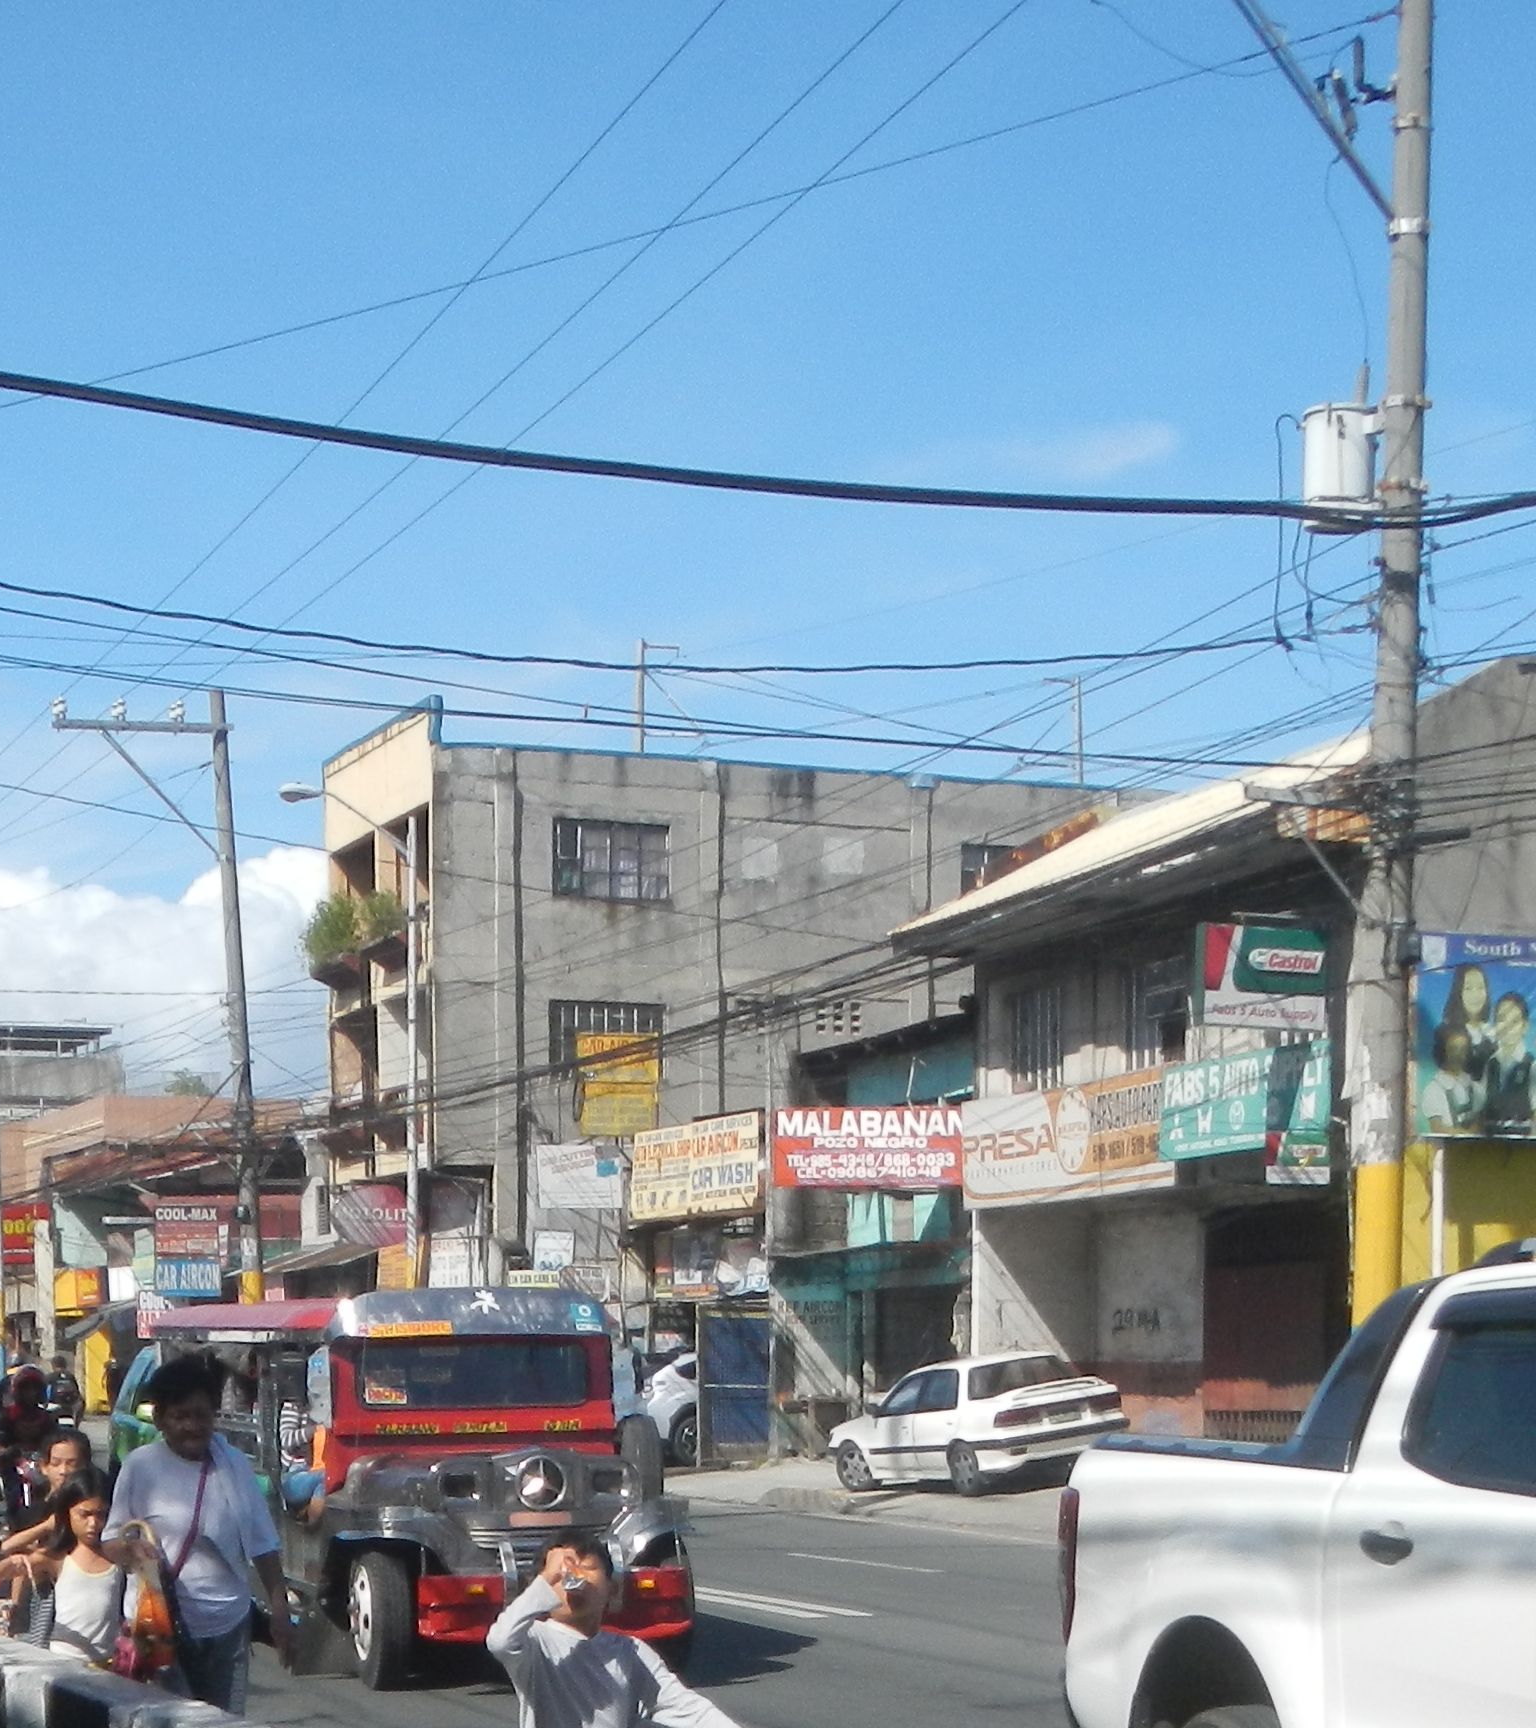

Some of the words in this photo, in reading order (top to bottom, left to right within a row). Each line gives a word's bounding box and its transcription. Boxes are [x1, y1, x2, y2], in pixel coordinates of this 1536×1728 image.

[1464, 939, 1521, 957] South
[1268, 953, 1318, 970] Castrol
[1249, 1006, 1276, 1017] Auto
[1280, 1008, 1318, 1022] Supply
[1164, 1068, 1206, 1108] FABS
[1208, 1065, 1221, 1099] 5
[1223, 1058, 1260, 1099] AUTO
[777, 1110, 964, 1137] MALABANAN
[813, 1137, 859, 1149] POZO
[863, 1137, 928, 1149] NEGRO
[964, 1123, 1056, 1164] PRESA
[691, 1166, 713, 1191] CAR
[717, 1162, 754, 1186] WASH
[155, 1207, 217, 1221] COOL-MAX
[156, 1263, 178, 1290] CAR
[180, 1263, 222, 1290] AIRCON
